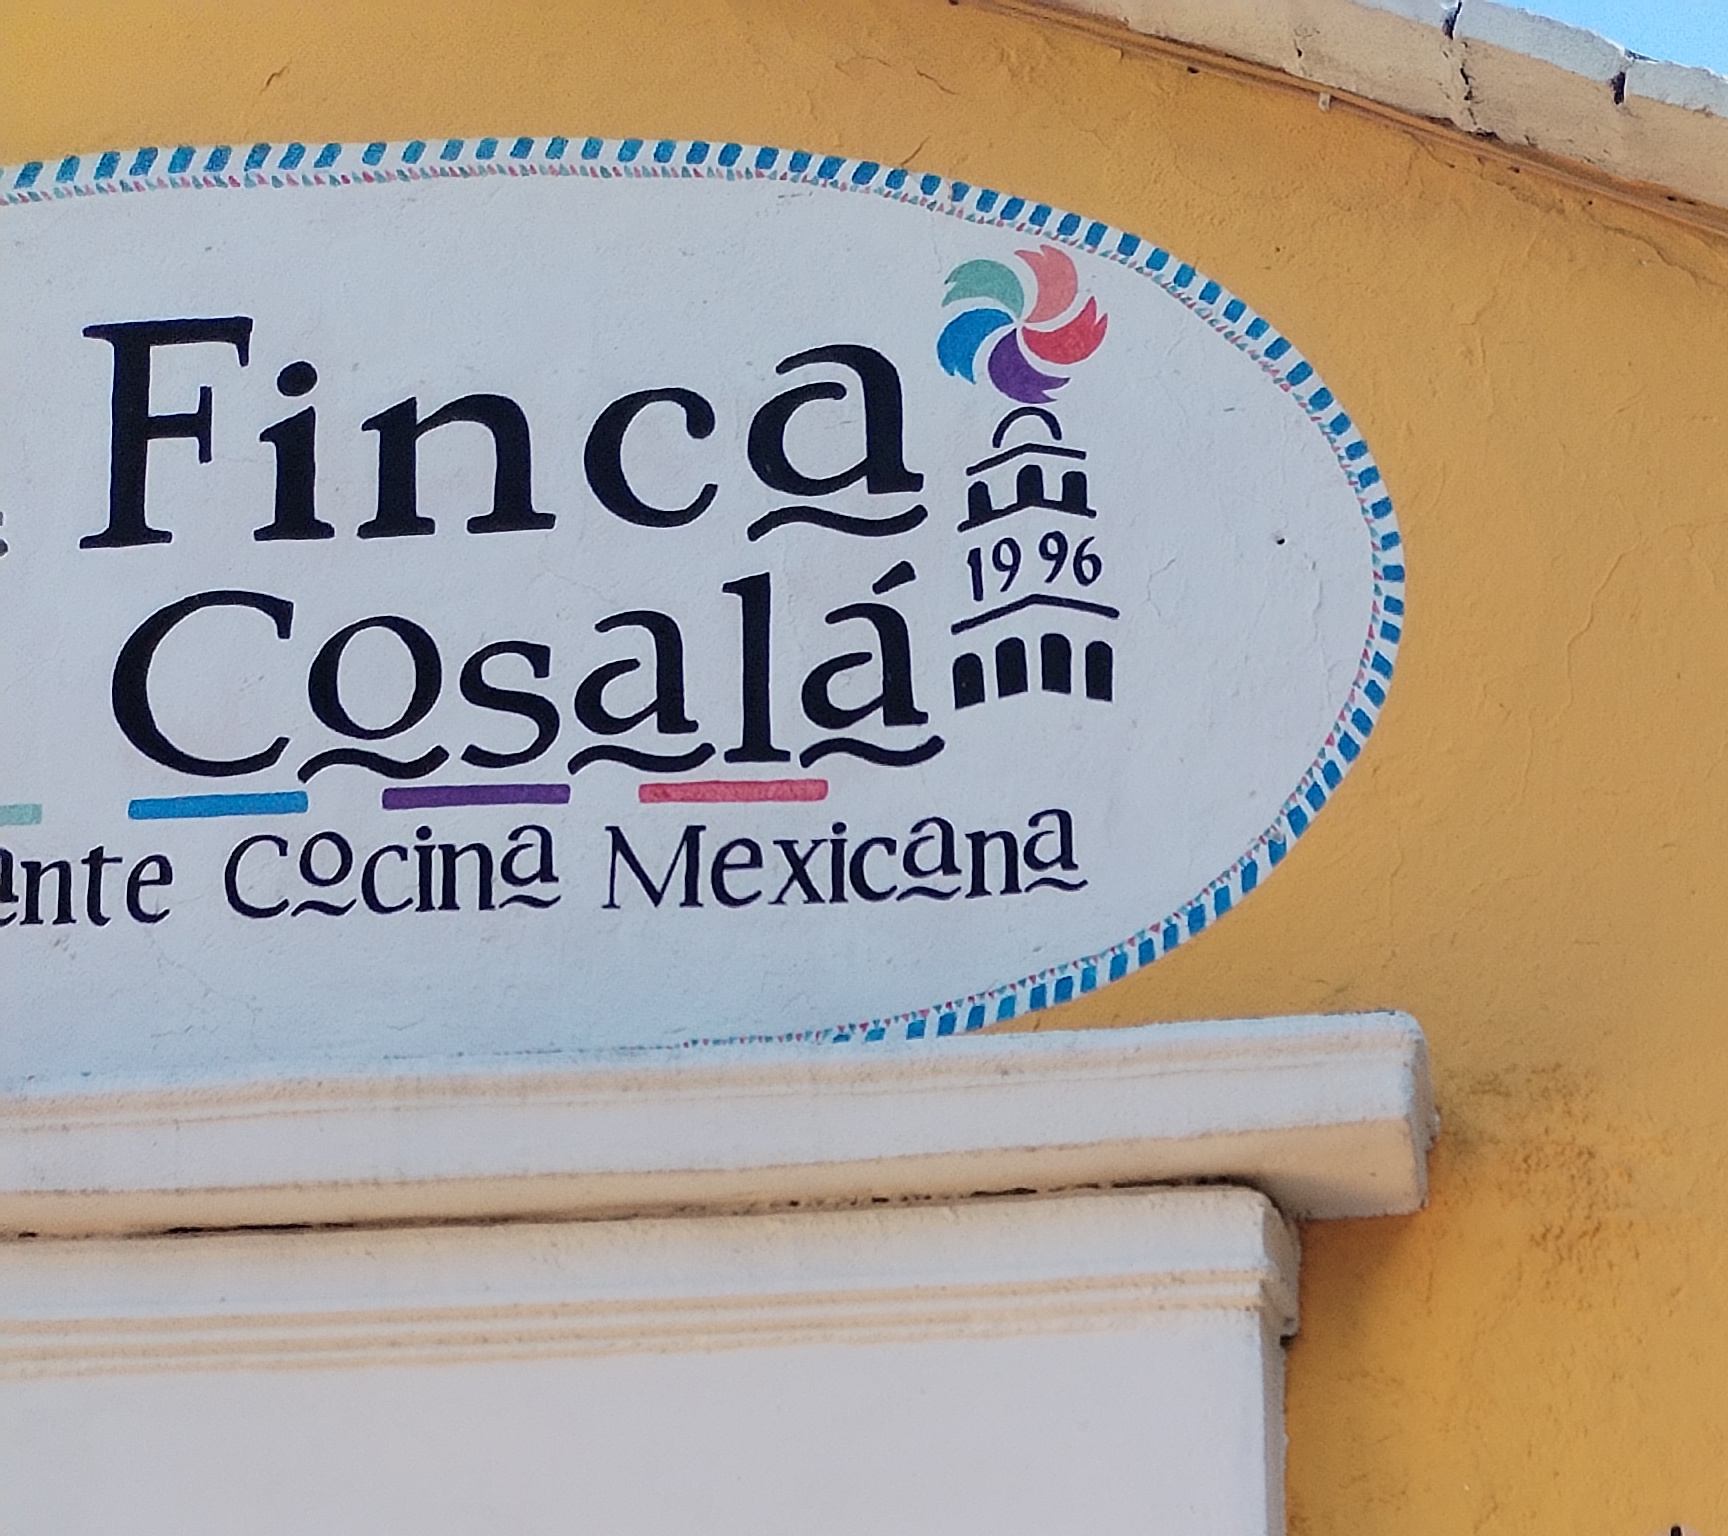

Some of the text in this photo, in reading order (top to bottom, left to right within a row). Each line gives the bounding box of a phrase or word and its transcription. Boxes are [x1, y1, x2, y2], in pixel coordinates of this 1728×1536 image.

[79, 315, 927, 548] Finca
[967, 530, 1103, 602] 1996
[110, 561, 945, 782] Cosalá
[224, 822, 561, 924] Cocina
[602, 807, 1088, 909] Mexicana
